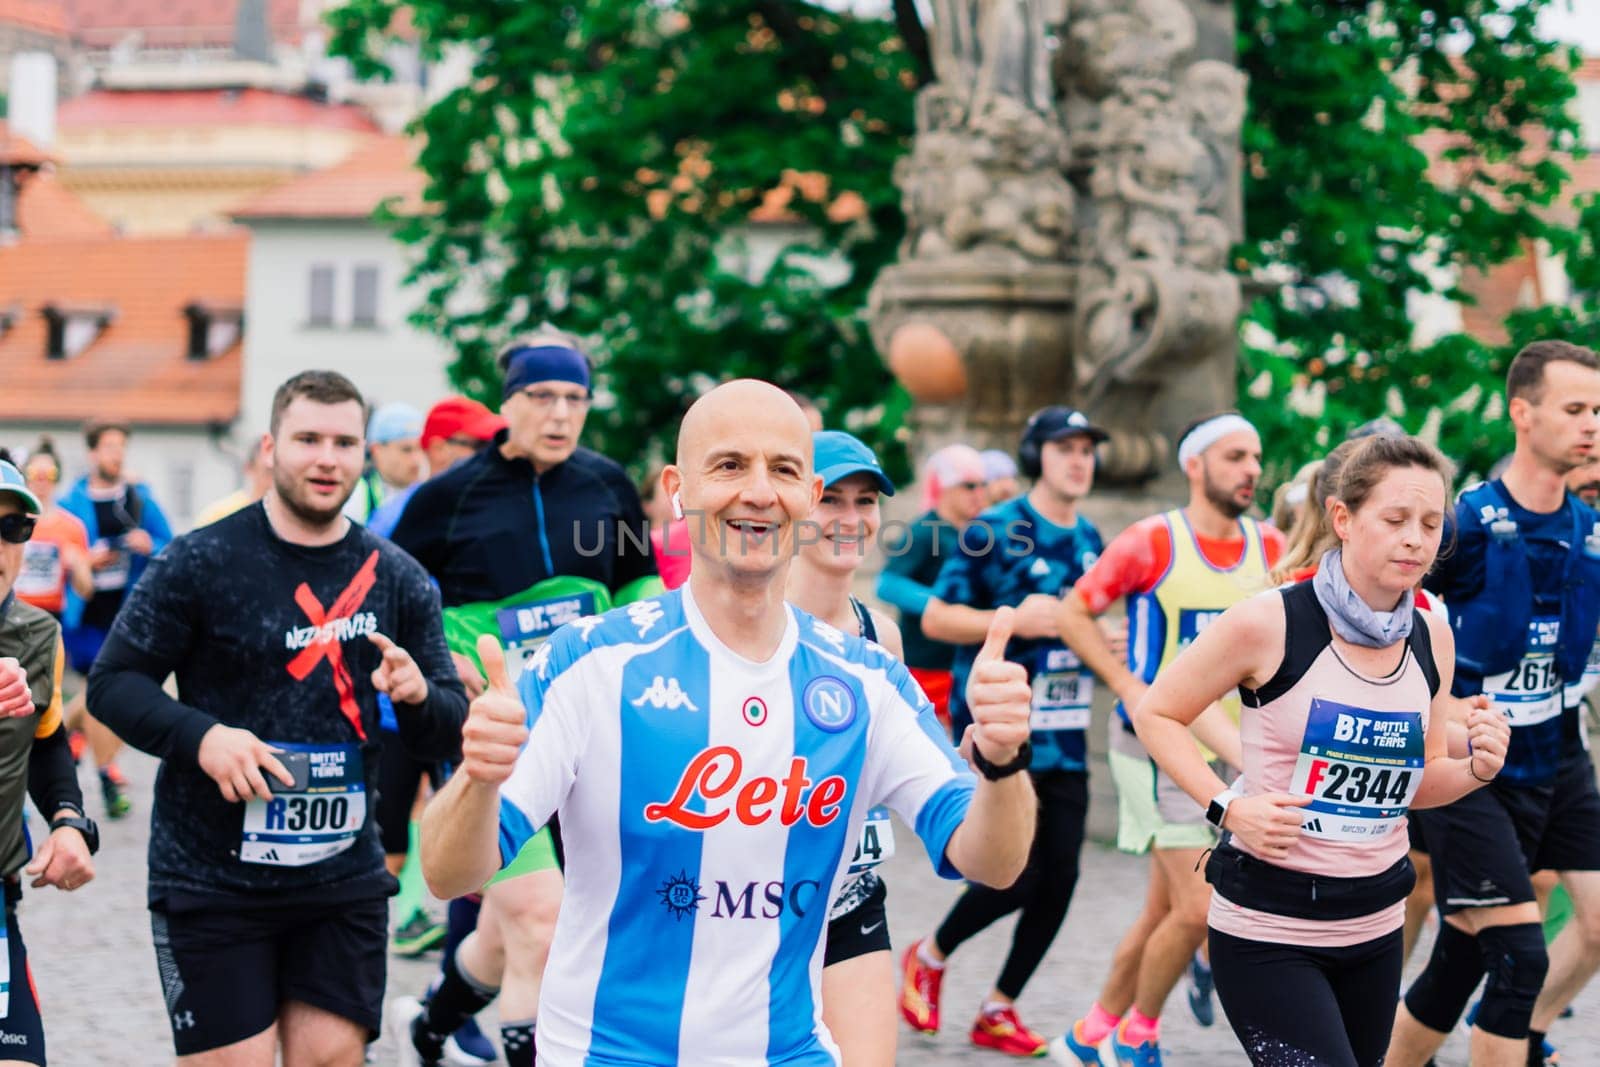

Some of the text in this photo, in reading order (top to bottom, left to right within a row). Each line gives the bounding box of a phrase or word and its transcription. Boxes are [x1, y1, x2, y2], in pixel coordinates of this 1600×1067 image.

[818, 690, 842, 717] N
[1373, 720, 1409, 733] BATTLE
[1373, 735, 1406, 748] TEAMS
[645, 746, 846, 830] Lete
[1304, 759, 1412, 805] F2344
[265, 797, 349, 831] R300
[710, 879, 820, 920] MSC
